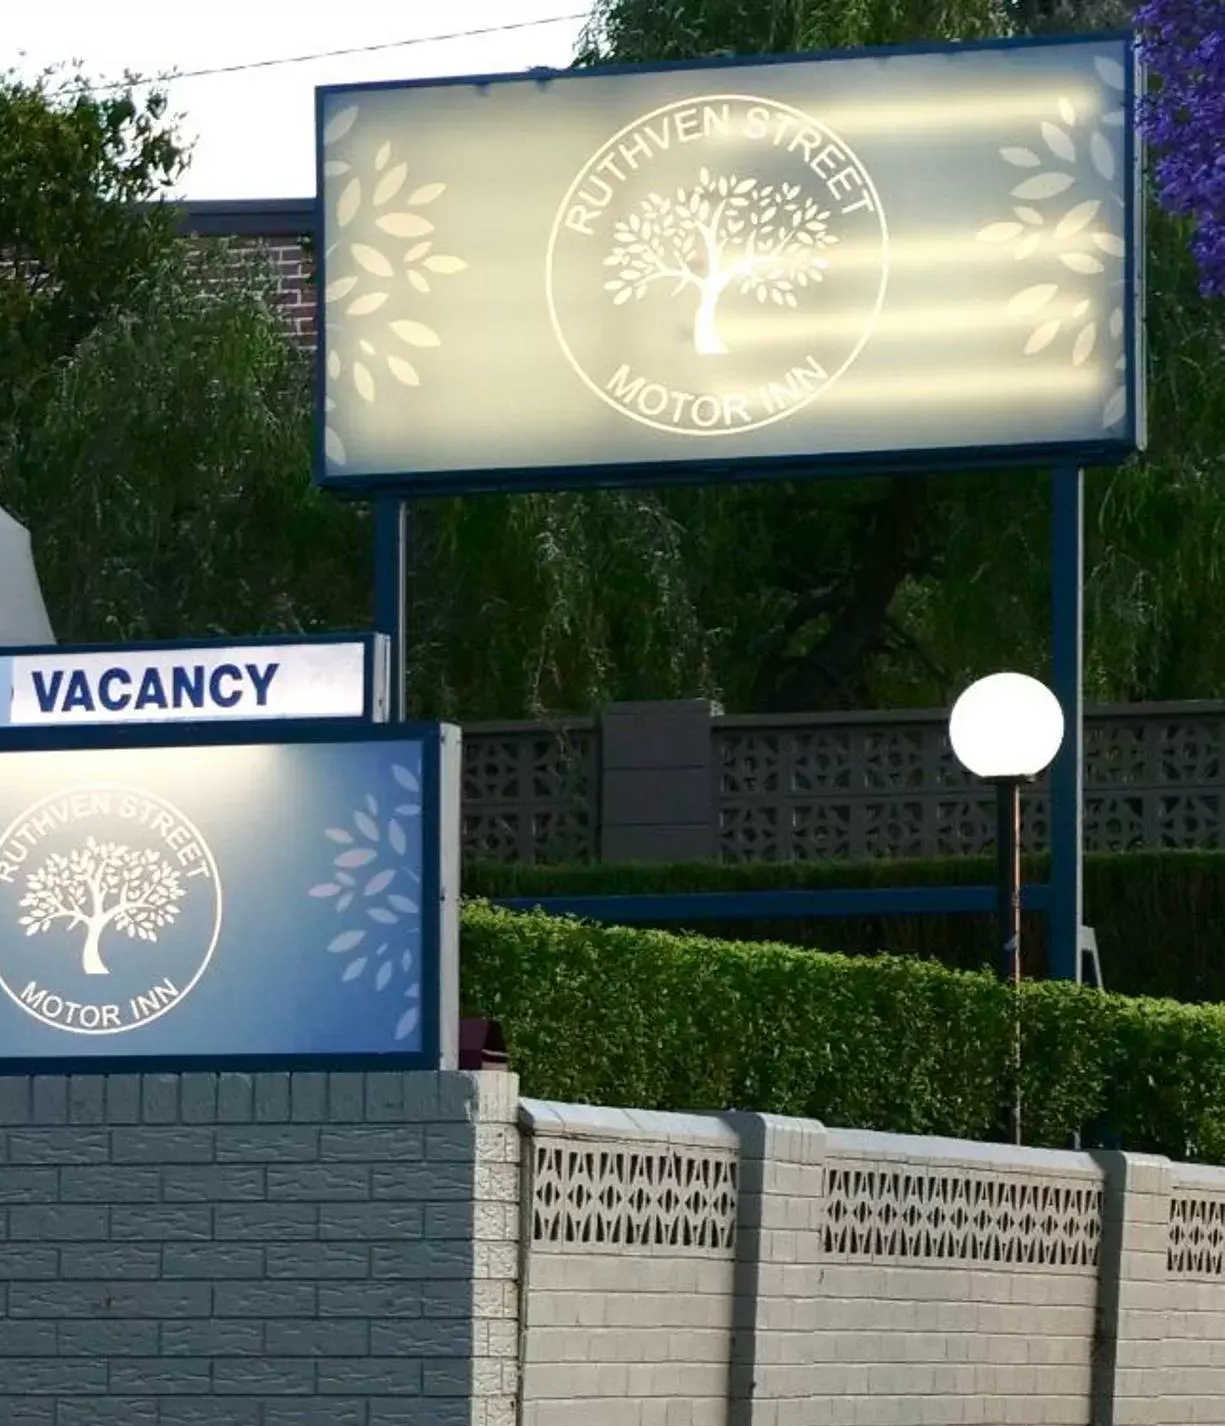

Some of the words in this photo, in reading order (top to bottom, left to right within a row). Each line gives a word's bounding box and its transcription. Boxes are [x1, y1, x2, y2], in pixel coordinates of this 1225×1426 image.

[565, 104, 730, 237] RUTHVEN
[746, 105, 876, 217] STREET
[606, 363, 748, 428] MOTOR
[760, 355, 829, 417] INN
[32, 662, 280, 713] VACANCY
[118, 795, 213, 880] STREET
[20, 980, 121, 1028] MOTOR
[130, 977, 180, 1021] INN
